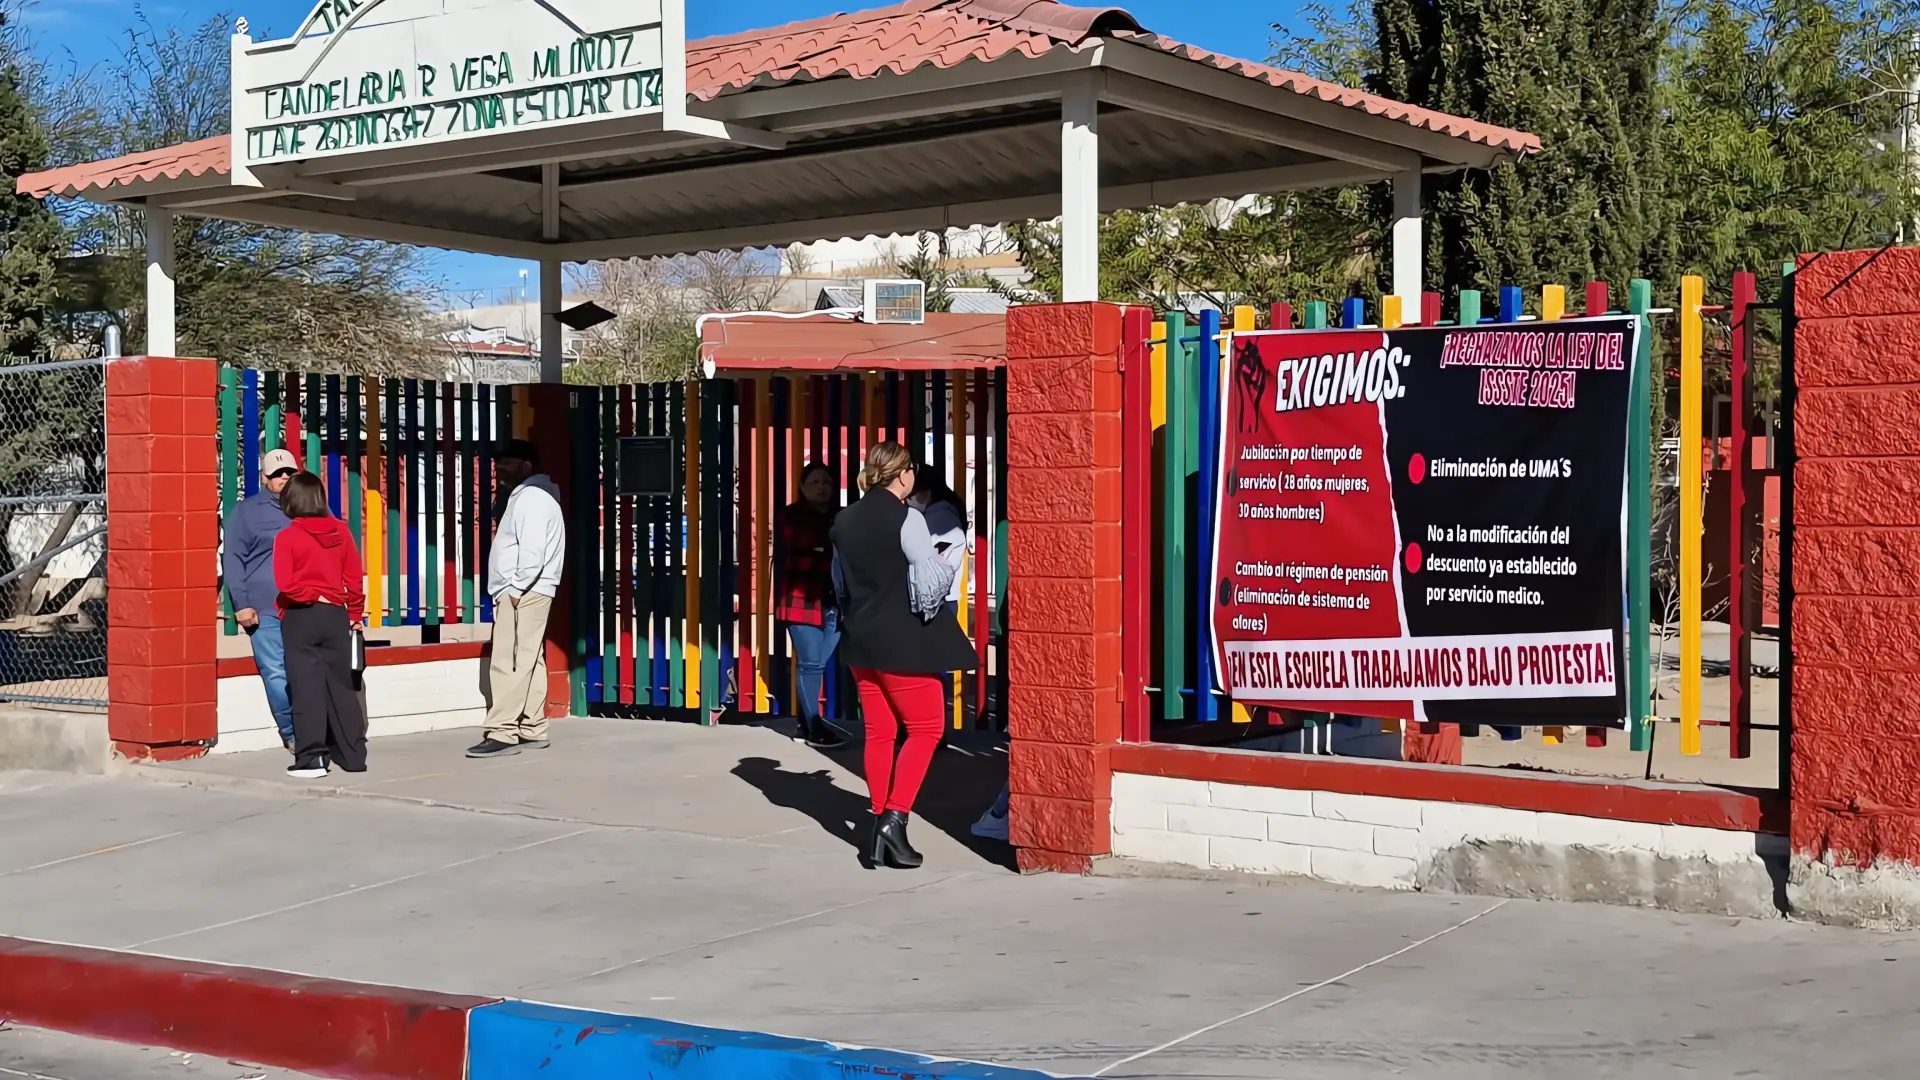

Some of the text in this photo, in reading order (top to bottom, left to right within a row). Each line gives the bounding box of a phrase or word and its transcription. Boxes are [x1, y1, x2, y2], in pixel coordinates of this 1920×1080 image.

[417, 63, 435, 98] R
[450, 51, 514, 92] VEGA
[443, 94, 508, 135] ZONA
[1546, 332, 1565, 369] LA
[1566, 332, 1595, 370] LEY
[1595, 332, 1625, 371] DEL
[1275, 346, 1412, 412] EXIGIMOS:
[1478, 368, 1529, 406] ISSSTE
[1241, 444, 1362, 465] Jubilación por tiempo de
[1430, 457, 1507, 477] Eliminación
[1509, 459, 1527, 477] de
[1239, 473, 1277, 490] servicio
[1297, 475, 1323, 491] años
[1325, 474, 1370, 496] mujeres,
[1238, 501, 1325, 524] 30 años hombres)
[1427, 524, 1570, 545] No a la modificación del
[1235, 560, 1388, 586] Cambio al régimen de pensión
[1426, 553, 1577, 578] descuento ya establecido
[1234, 584, 1370, 609] (eliminación de sistema de
[1426, 584, 1545, 606] por servicio medico.
[1232, 612, 1268, 635] afores)
[1249, 651, 1283, 689] ESTA
[1285, 650, 1350, 689] ESCUELA
[1351, 647, 1463, 690] TRABAJAMOS
[1466, 645, 1513, 687] BAJO
[1517, 641, 1614, 686] PROTESTA!
